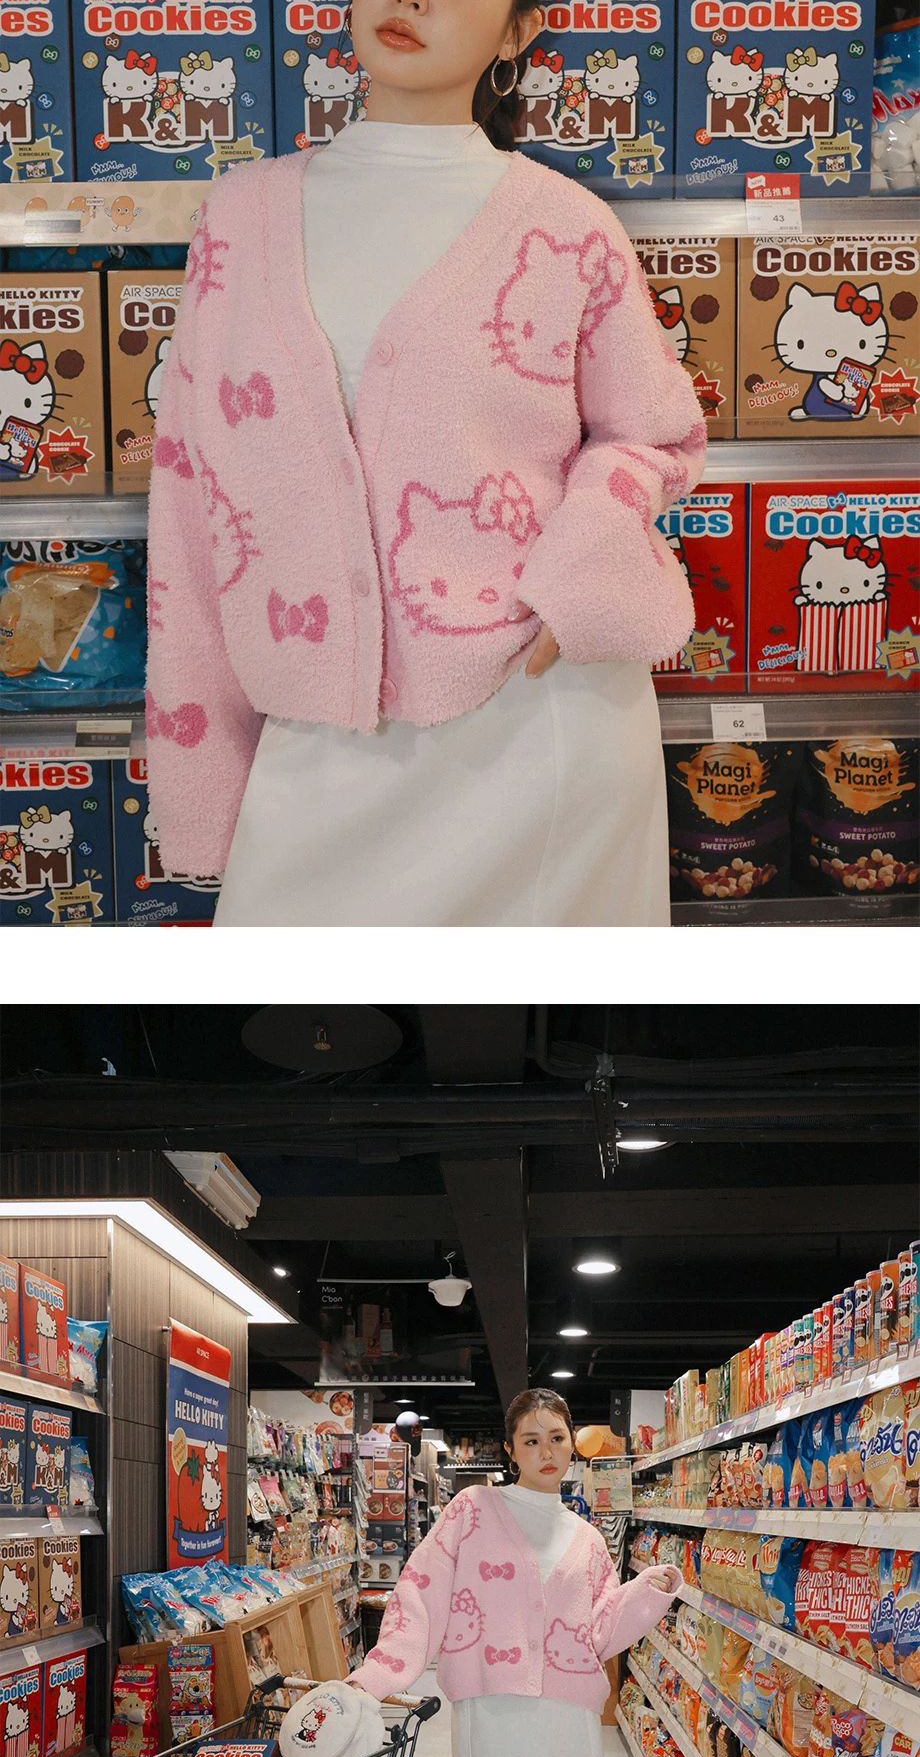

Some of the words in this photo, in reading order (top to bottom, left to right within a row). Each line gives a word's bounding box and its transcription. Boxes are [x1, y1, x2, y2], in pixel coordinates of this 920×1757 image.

[88, 4, 252, 32] Cookies
[695, 2, 858, 27] Cookies
[753, 186, 791, 197] 新品推薦
[757, 247, 915, 273] Cookies
[733, 720, 744, 728] 62
[703, 761, 752, 781] Magi
[697, 780, 756, 797] Planet
[701, 842, 727, 850] SWEET
[729, 840, 756, 849] POTATO
[322, 1295, 342, 1303] C'bon
[175, 1400, 200, 1424] HELLO
[202, 1410, 225, 1430] KITTY
[33, 1419, 69, 1438] Cookies
